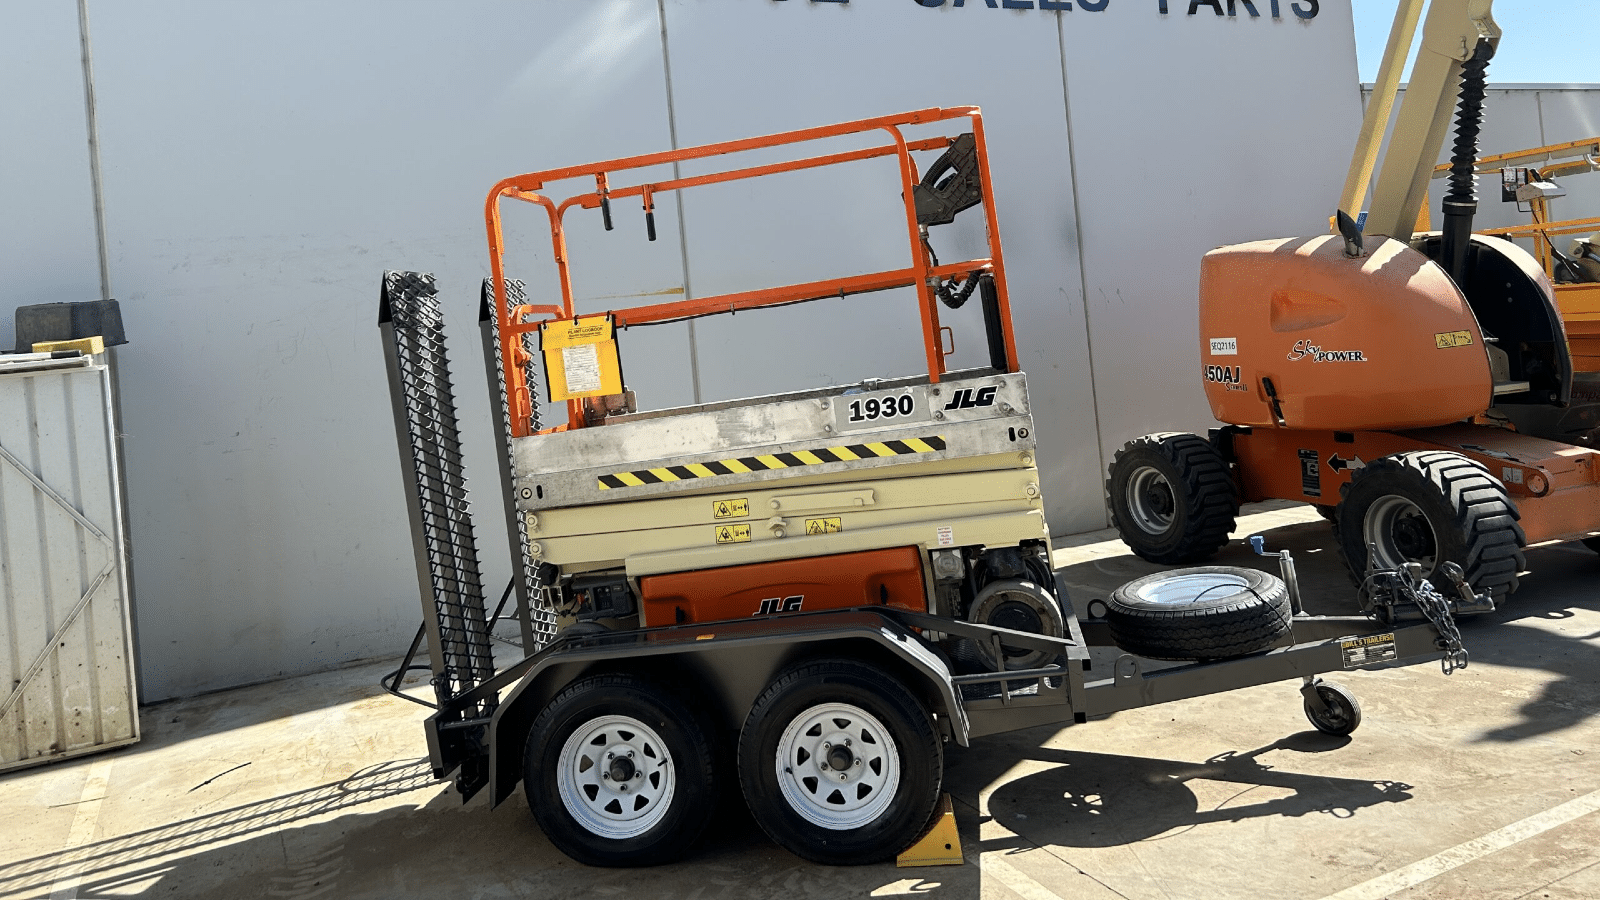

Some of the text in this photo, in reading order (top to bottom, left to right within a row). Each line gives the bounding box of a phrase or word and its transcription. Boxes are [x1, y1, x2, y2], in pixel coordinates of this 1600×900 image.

[1211, 341, 1236, 351] SEQ2116
[1204, 364, 1241, 384] 450AJ
[849, 394, 915, 423] 1930
[943, 385, 999, 411] JLG
[752, 595, 804, 616] JLG
